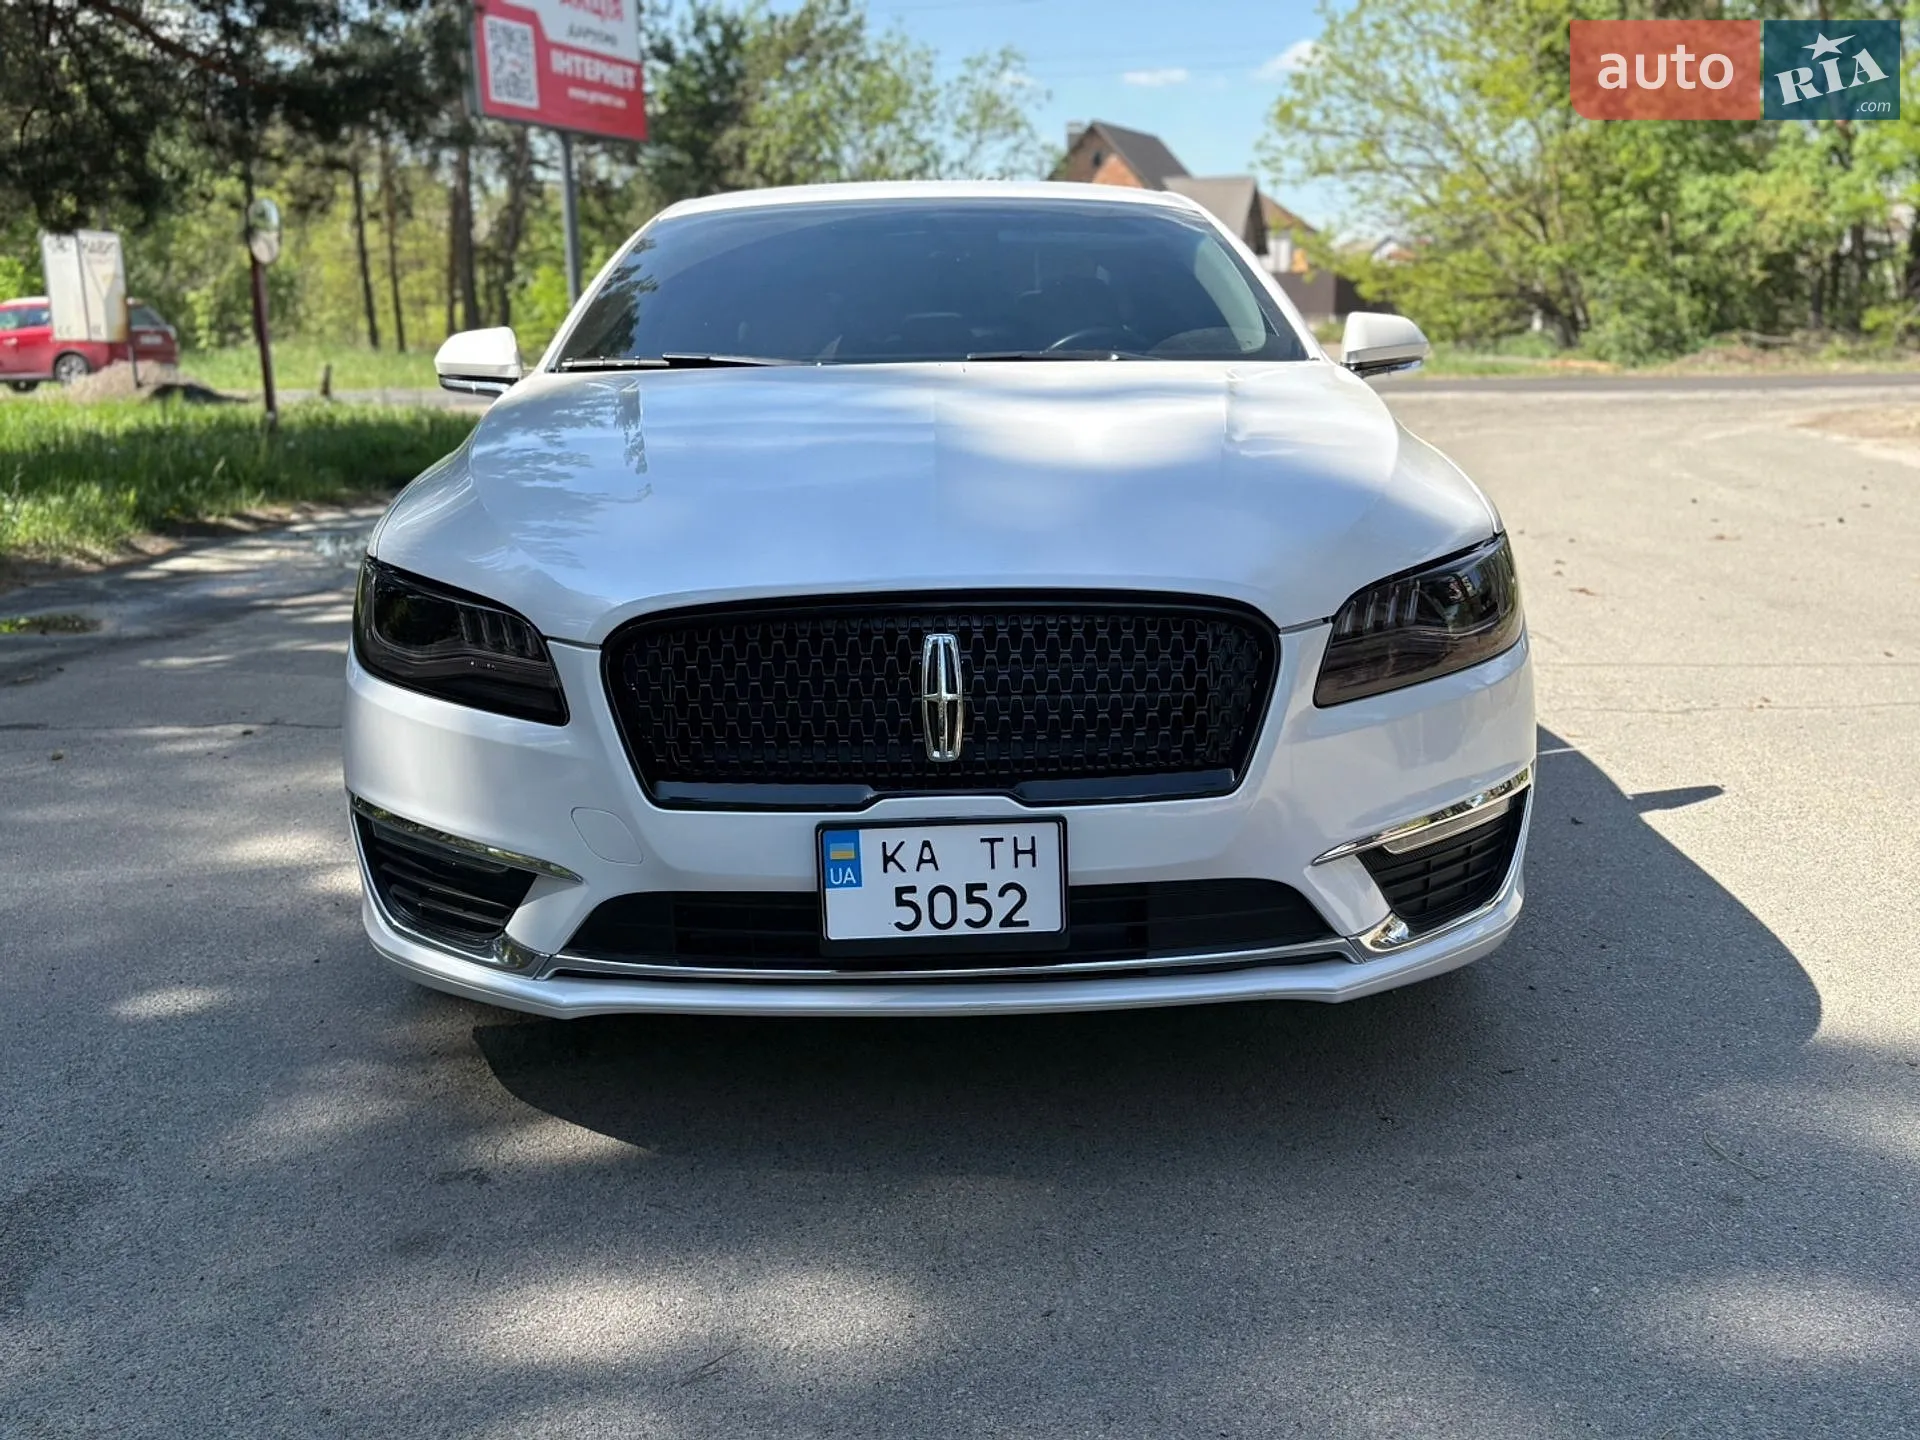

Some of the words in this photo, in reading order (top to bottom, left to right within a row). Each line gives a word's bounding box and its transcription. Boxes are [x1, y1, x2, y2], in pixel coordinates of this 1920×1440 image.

[551, 49, 637, 90] ІНТЕРНЕТ
[881, 839, 939, 873] KA
[980, 835, 1037, 870] TH
[829, 867, 857, 885] UA
[893, 881, 1030, 932] 5052
